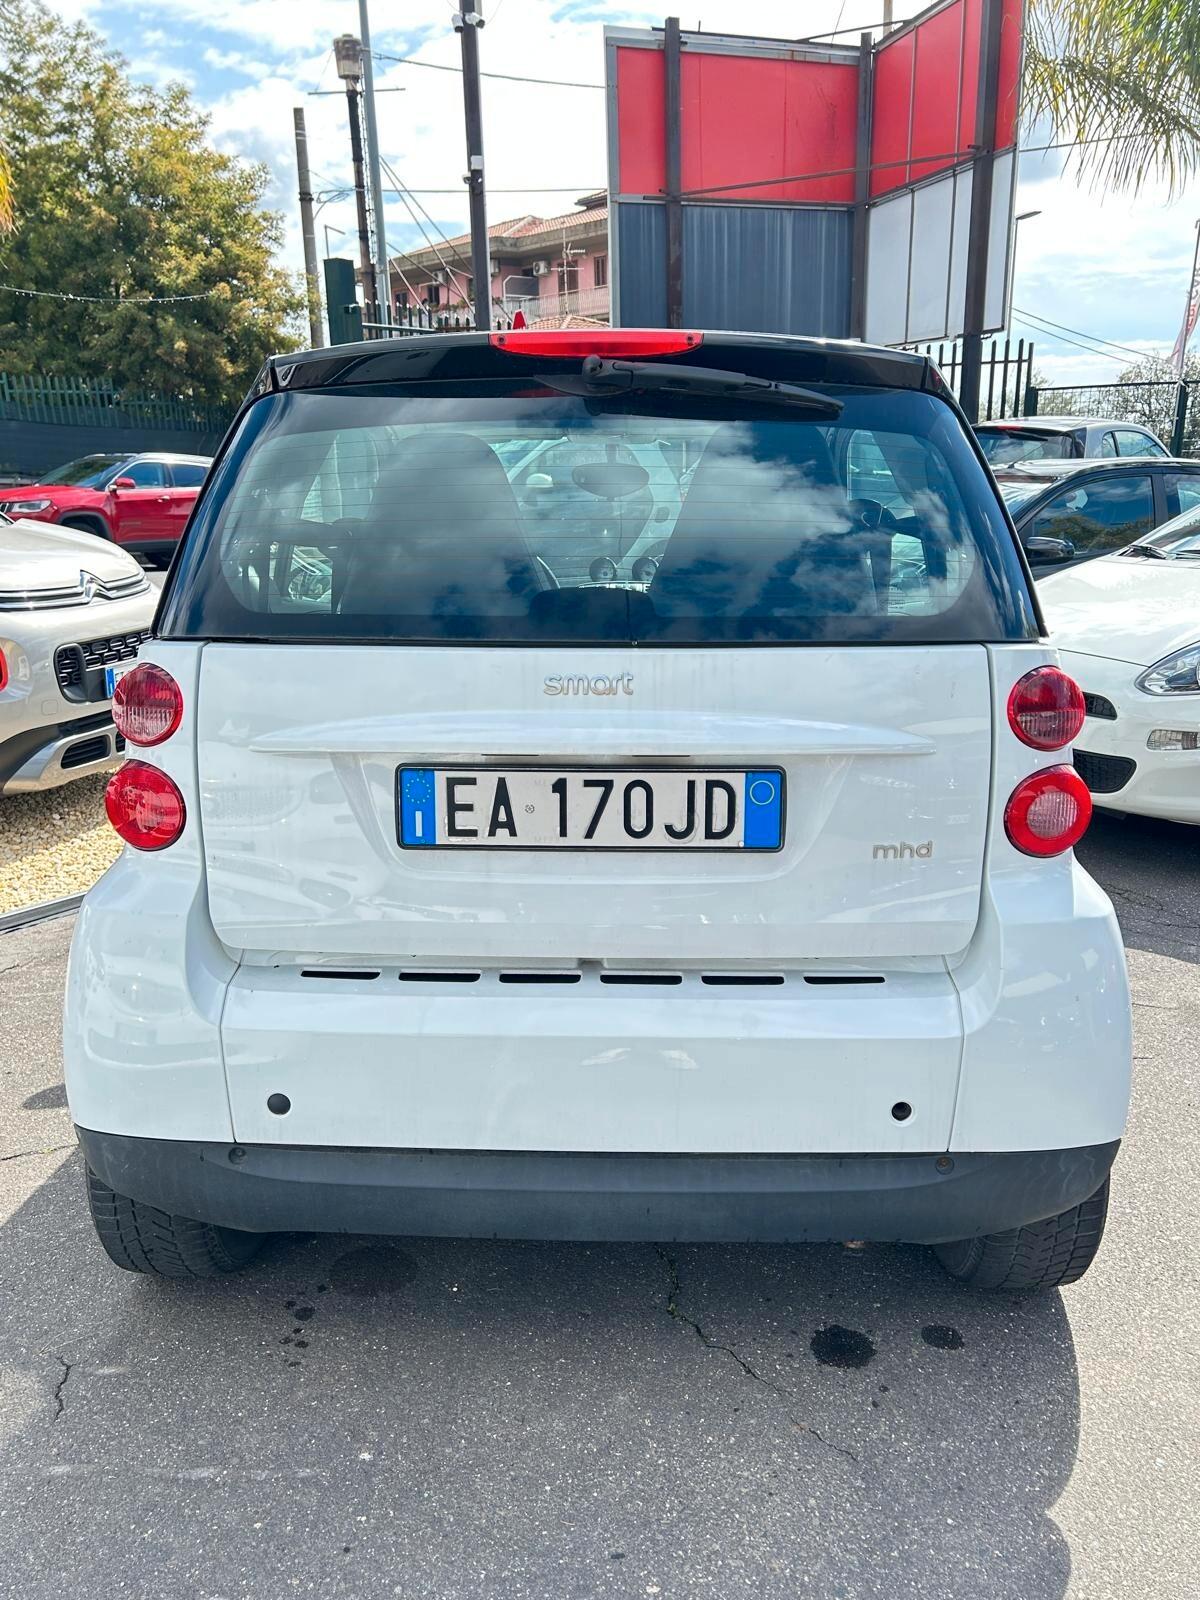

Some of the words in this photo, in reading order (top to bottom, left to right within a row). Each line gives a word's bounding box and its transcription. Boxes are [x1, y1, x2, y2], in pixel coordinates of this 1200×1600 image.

[543, 672, 634, 696] smart
[446, 776, 518, 838] EA
[551, 777, 737, 840] 170JD
[415, 810, 423, 837] I
[872, 840, 933, 860] mhd
